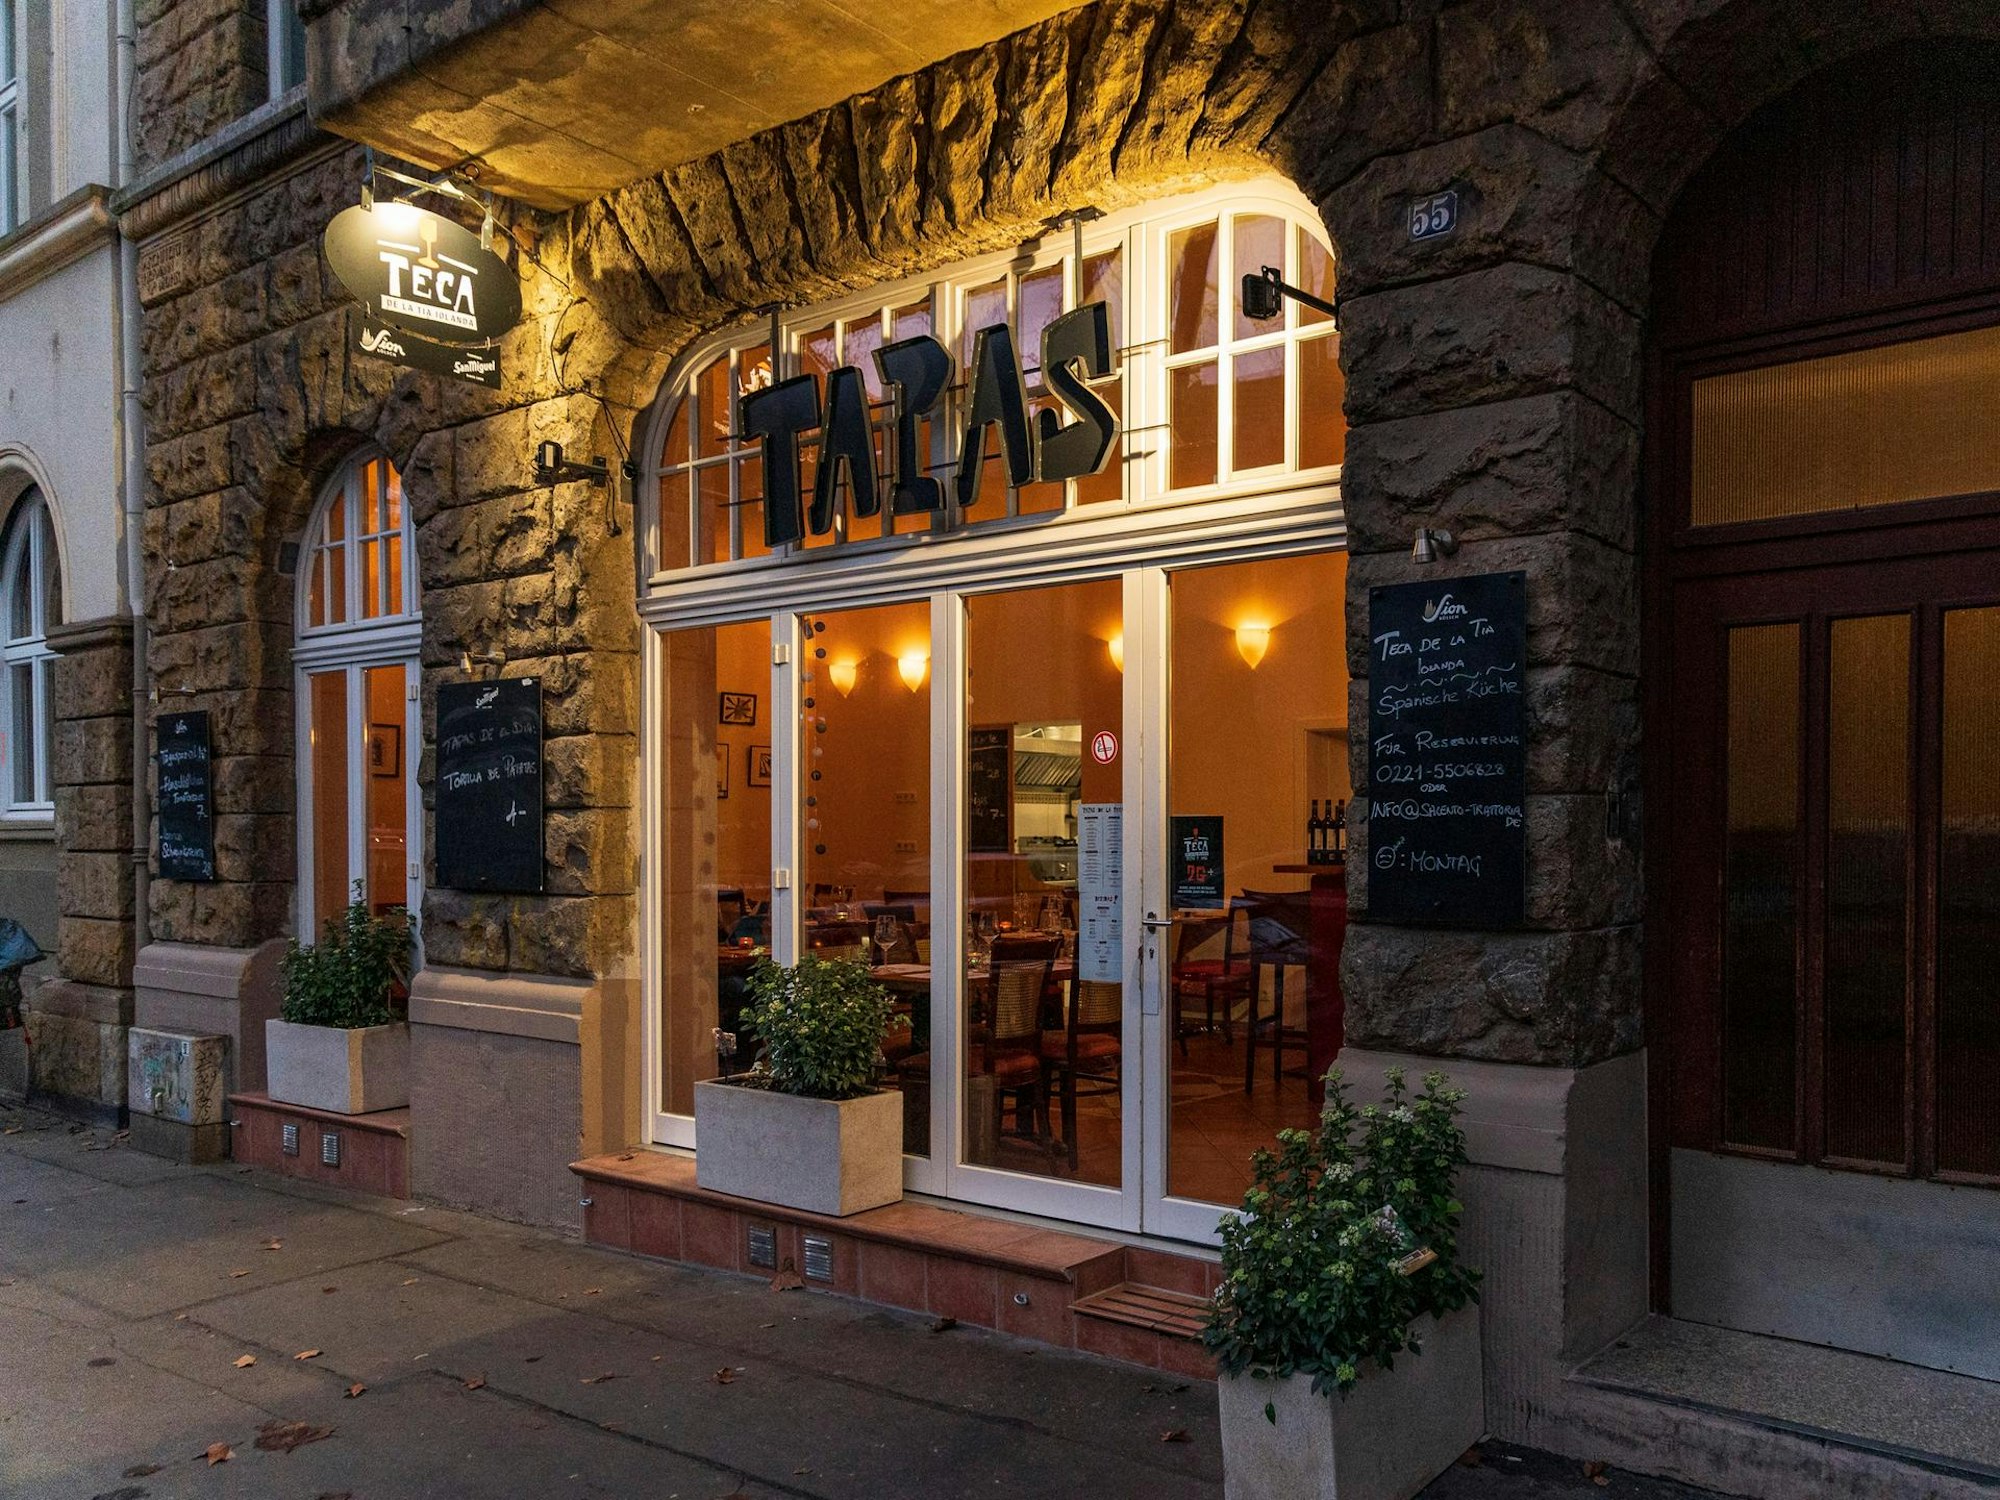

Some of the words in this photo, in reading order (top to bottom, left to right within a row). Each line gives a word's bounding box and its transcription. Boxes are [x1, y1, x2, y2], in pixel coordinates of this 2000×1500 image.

[1412, 195, 1450, 236] 55
[379, 251, 474, 315] TECA
[386, 299, 399, 308] DE
[402, 304, 414, 313] LA
[417, 306, 432, 317] TIA
[435, 311, 474, 328] IOLANDA
[359, 329, 405, 356] Sion
[738, 299, 1122, 548] TAPAS
[1422, 593, 1468, 623] Sion
[1418, 636, 1442, 652] DE
[1449, 634, 1466, 646] LA
[1376, 688, 1459, 720] Spanische
[1466, 676, 1523, 698] Küche
[1183, 840, 1209, 853] TECA
